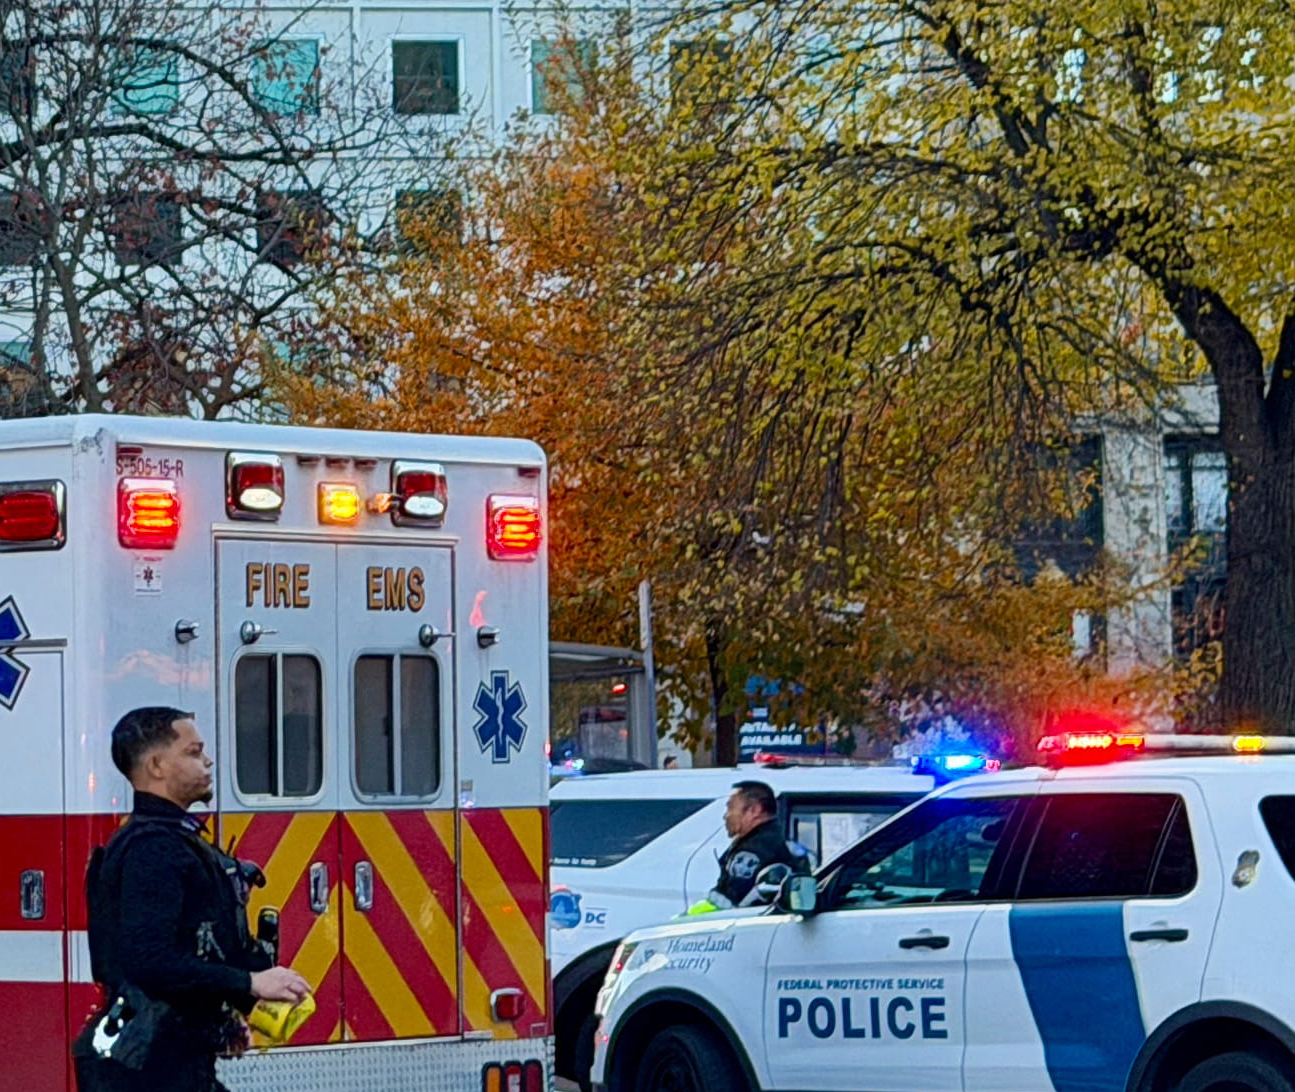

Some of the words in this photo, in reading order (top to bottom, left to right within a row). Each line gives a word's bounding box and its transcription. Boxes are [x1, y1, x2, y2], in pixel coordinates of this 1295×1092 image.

[246, 562, 310, 608] FIRE
[366, 566, 425, 613] EMS
[585, 912, 607, 924] DC
[667, 933, 736, 954] Homeland
[777, 979, 823, 990] FEDERAL
[826, 978, 893, 990] PROTECTIVE
[897, 978, 944, 990] SERVICE
[778, 996, 948, 1040] POLICE
